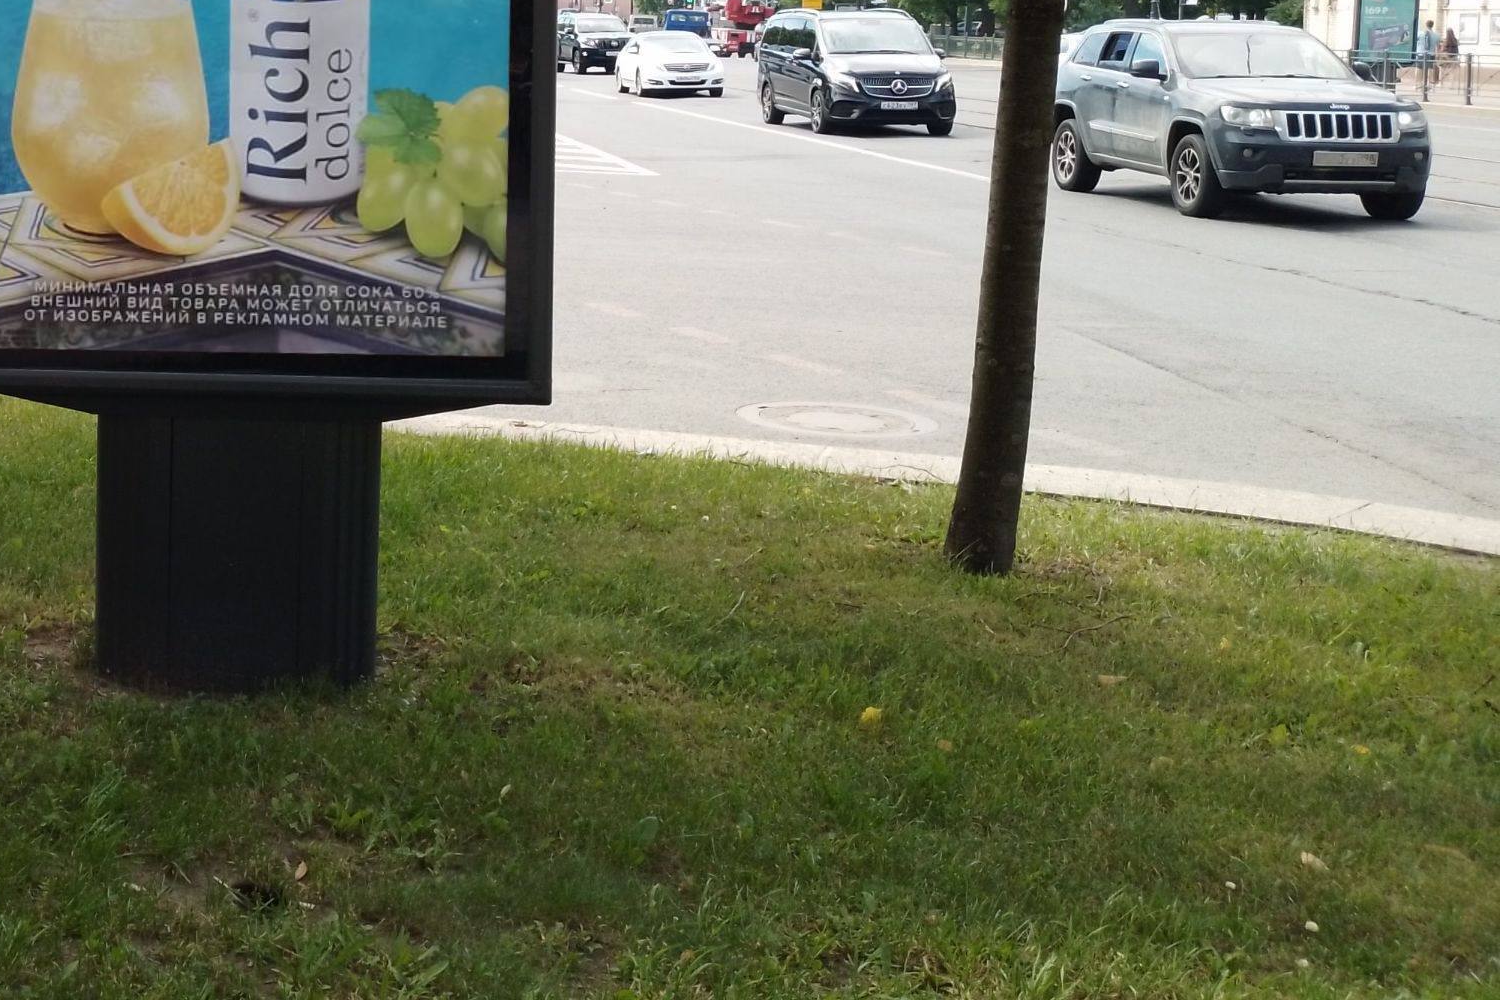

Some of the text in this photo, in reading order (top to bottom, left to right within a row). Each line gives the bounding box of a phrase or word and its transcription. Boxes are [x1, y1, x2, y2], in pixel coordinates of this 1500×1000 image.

[246, 16, 311, 182] Rich
[315, 47, 353, 181] dolce
[33, 281, 175, 295] МИНИМАЛЬНАЯ
[181, 283, 282, 296] ОБЪЕМНАЯ
[288, 285, 339, 298] ДОЛЯ
[345, 285, 395, 298] СОКА
[31, 294, 441, 313] ВНЕШНИЙ ВИД ТОВАРА МОЖЕТ ОТЛИЧАТЬСЯ
[24, 309, 448, 328] ОТ ИЗОБРАЖЕНИЙ В РЕКЛАМНОМ МАТЕРИАЛЕ
